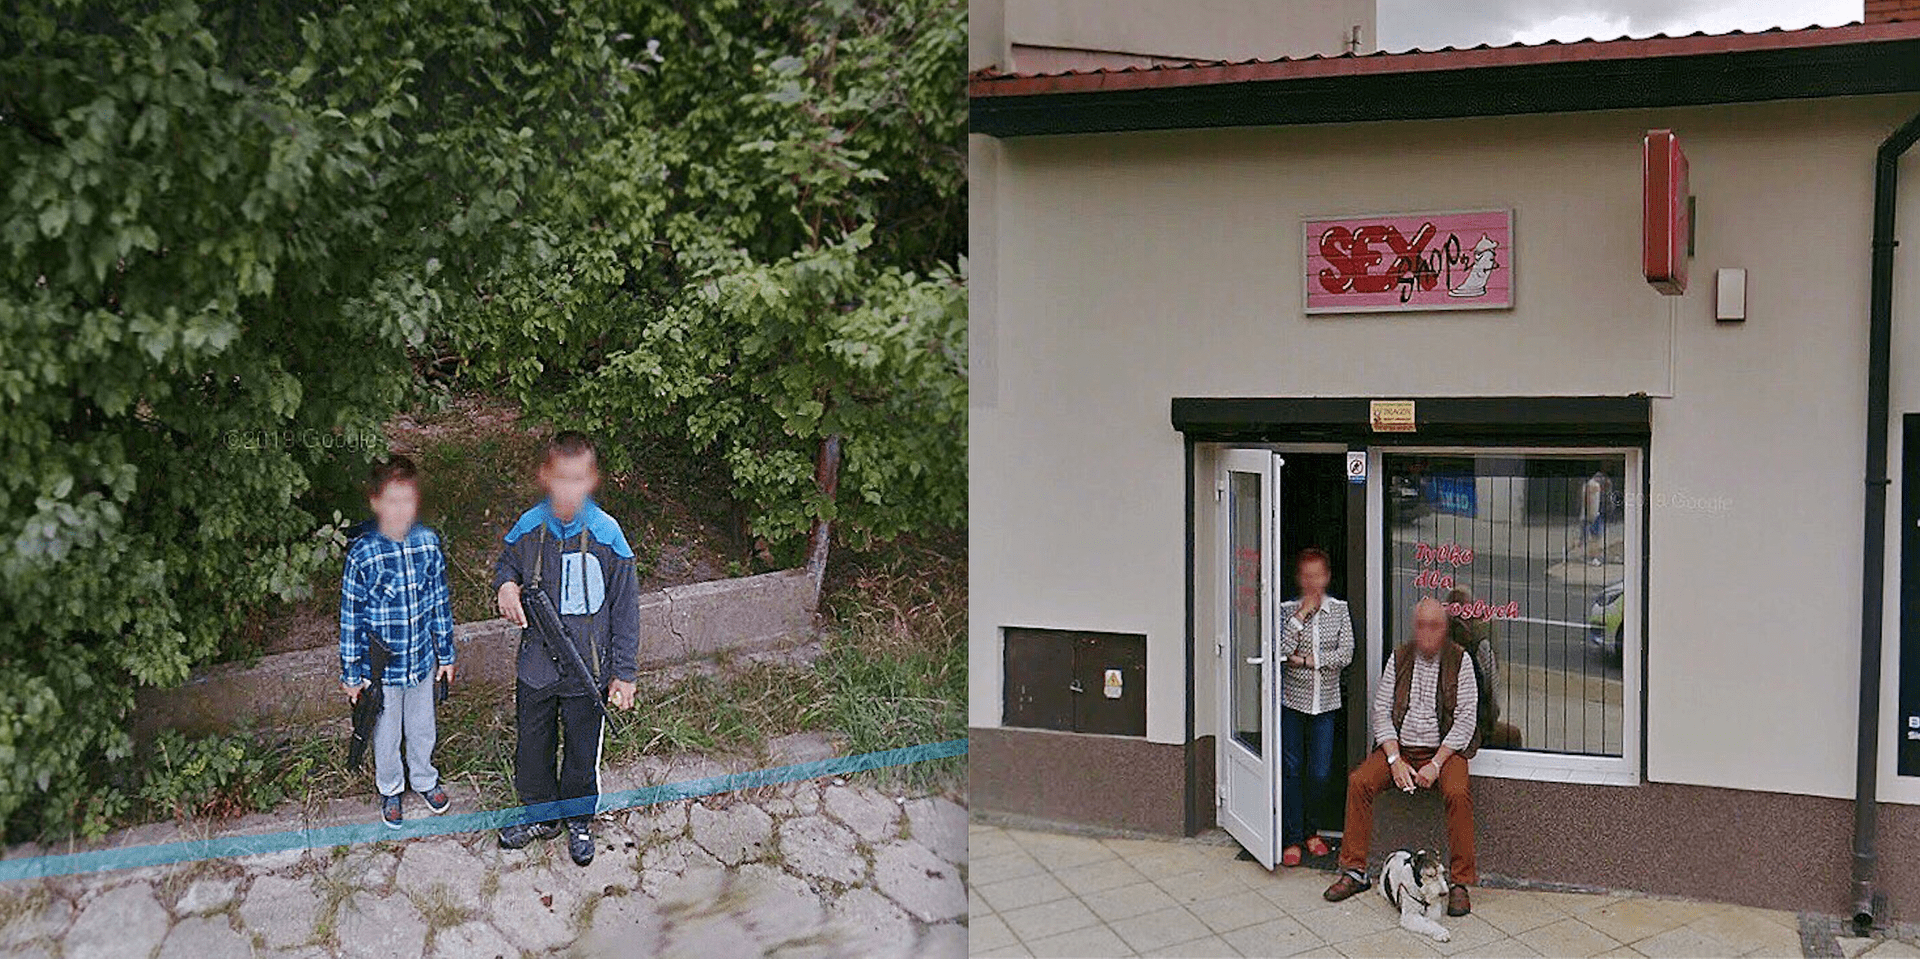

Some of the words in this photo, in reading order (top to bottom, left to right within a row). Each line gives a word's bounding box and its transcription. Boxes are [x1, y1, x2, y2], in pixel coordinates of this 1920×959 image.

[1319, 222, 1438, 294] SEX
[1415, 543, 1474, 568] Tylko
[1414, 569, 1454, 590] dla
